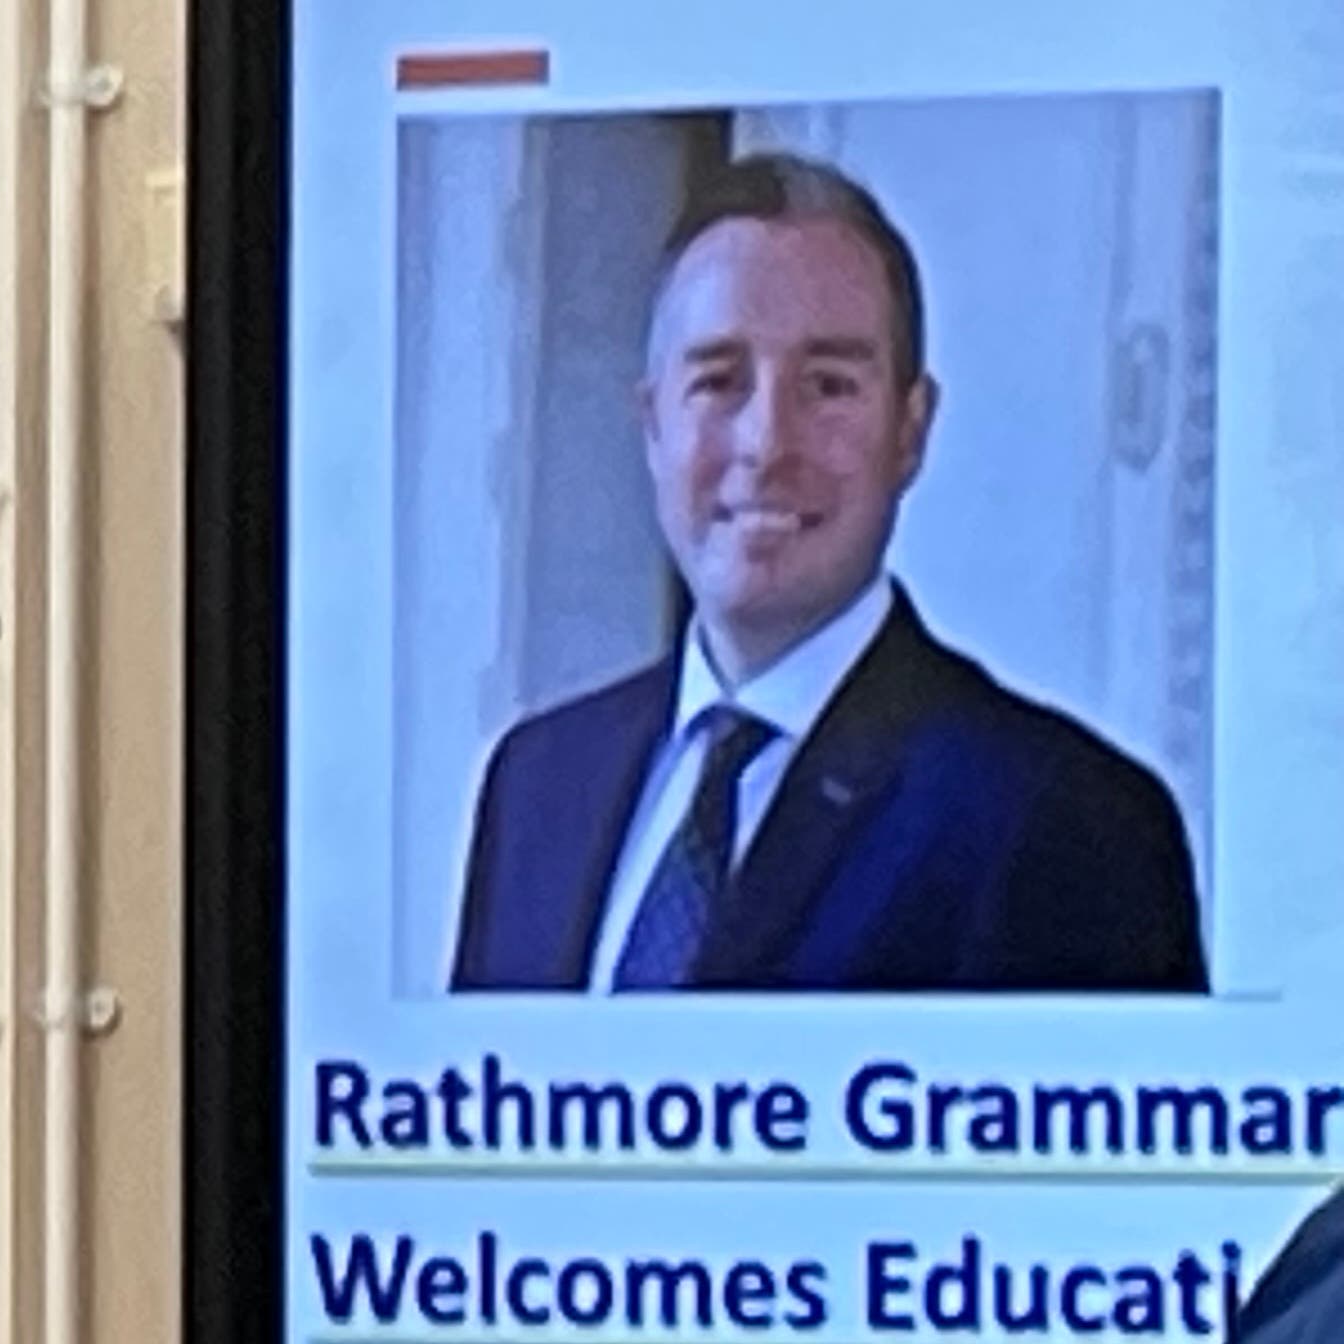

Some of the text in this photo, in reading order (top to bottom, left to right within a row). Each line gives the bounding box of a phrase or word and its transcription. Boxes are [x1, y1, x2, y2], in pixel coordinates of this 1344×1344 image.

[315, 1053, 1344, 1157] Rathmore Grammar
[311, 1229, 828, 1332] Welcomes
